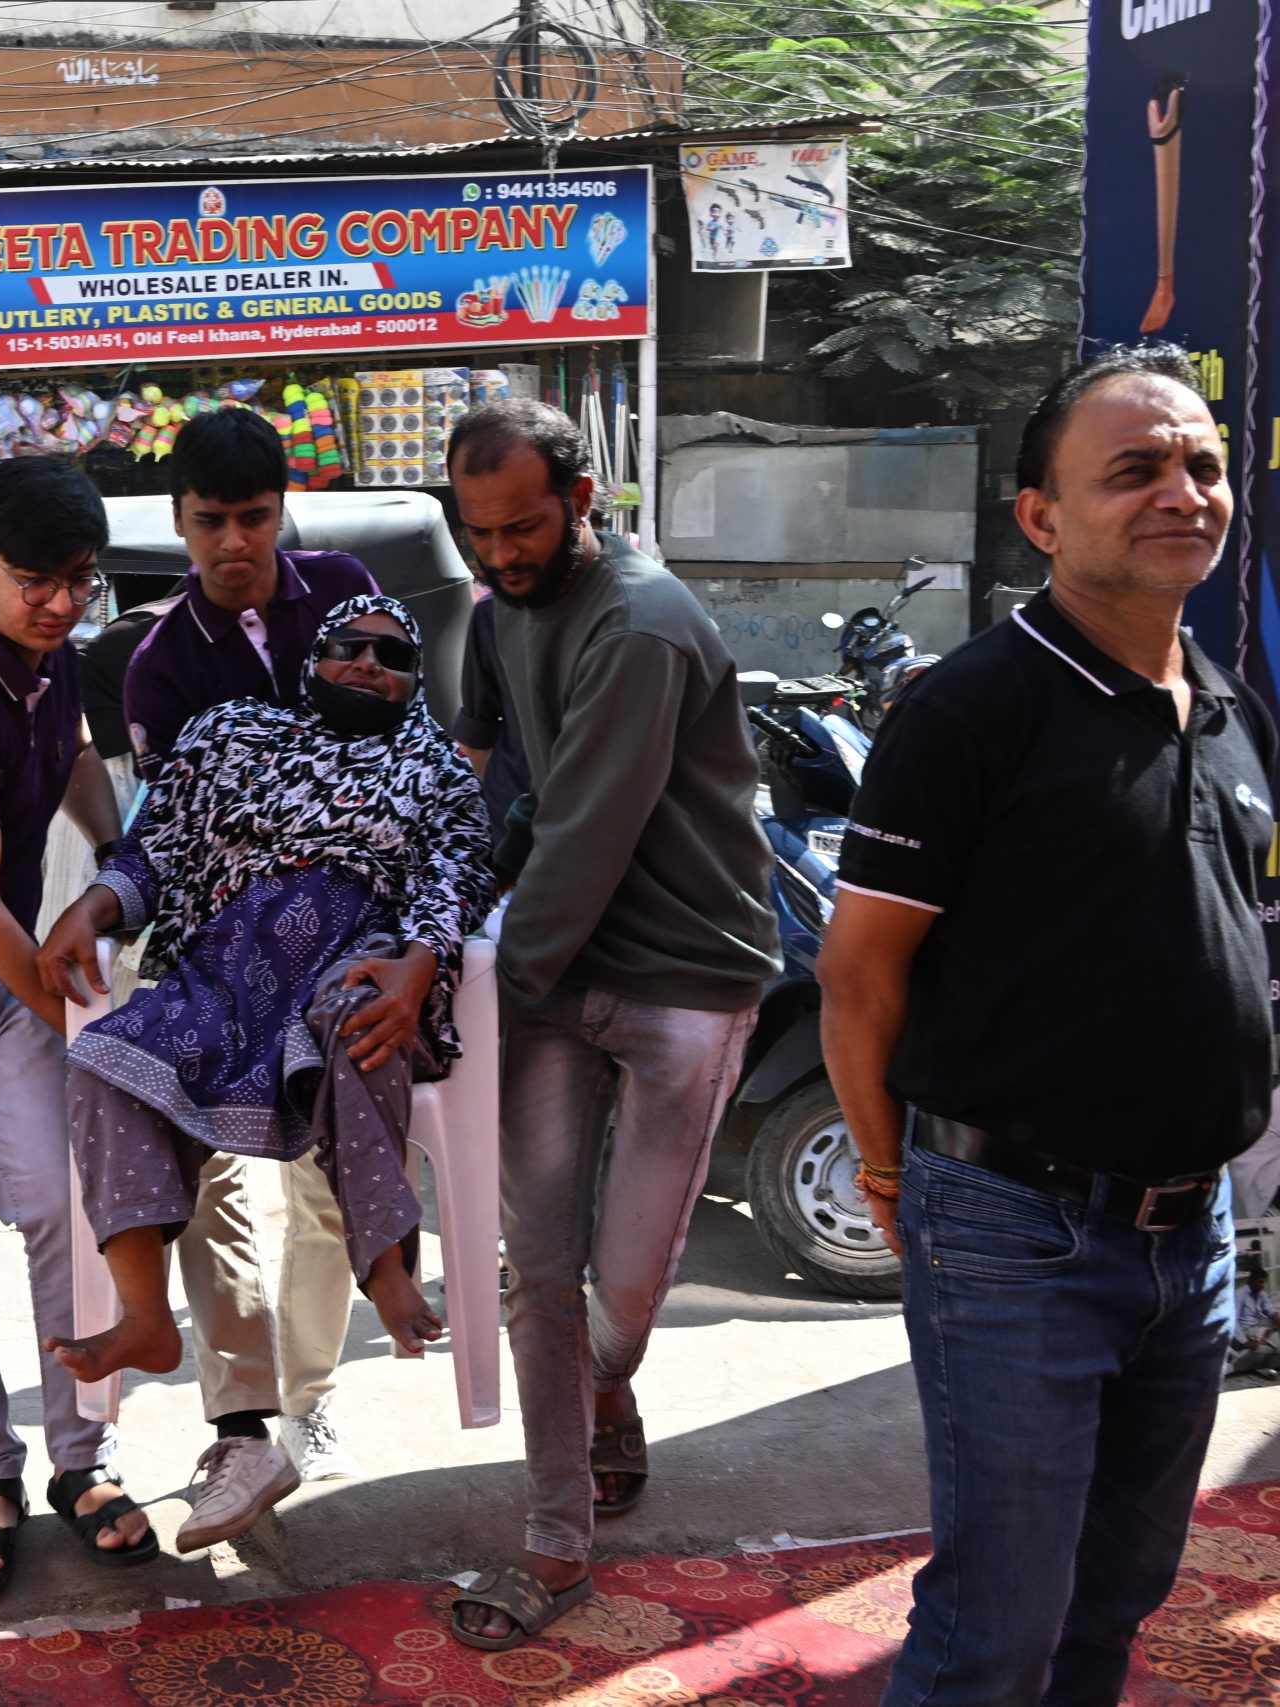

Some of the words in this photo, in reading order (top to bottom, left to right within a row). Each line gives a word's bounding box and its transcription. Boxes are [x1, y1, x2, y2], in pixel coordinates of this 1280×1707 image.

[497, 181, 617, 199] 9441354506
[100, 213, 328, 267] TRADING
[336, 203, 578, 258] COMPANY
[78, 275, 217, 298] WHOLESALE
[225, 271, 312, 292] DEALER
[320, 269, 349, 287] IN.
[107, 302, 209, 324] PLASTIC
[217, 301, 234, 320] &
[241, 295, 353, 318] GENERAL
[359, 290, 442, 312] GOODS
[6, 332, 129, 352] 15-1-503/A/51,
[133, 331, 163, 346] Old
[167, 329, 204, 344] Feel
[208, 328, 266, 344] khana,
[270, 321, 362, 342] Hyderabad
[376, 318, 438, 334] 500012
